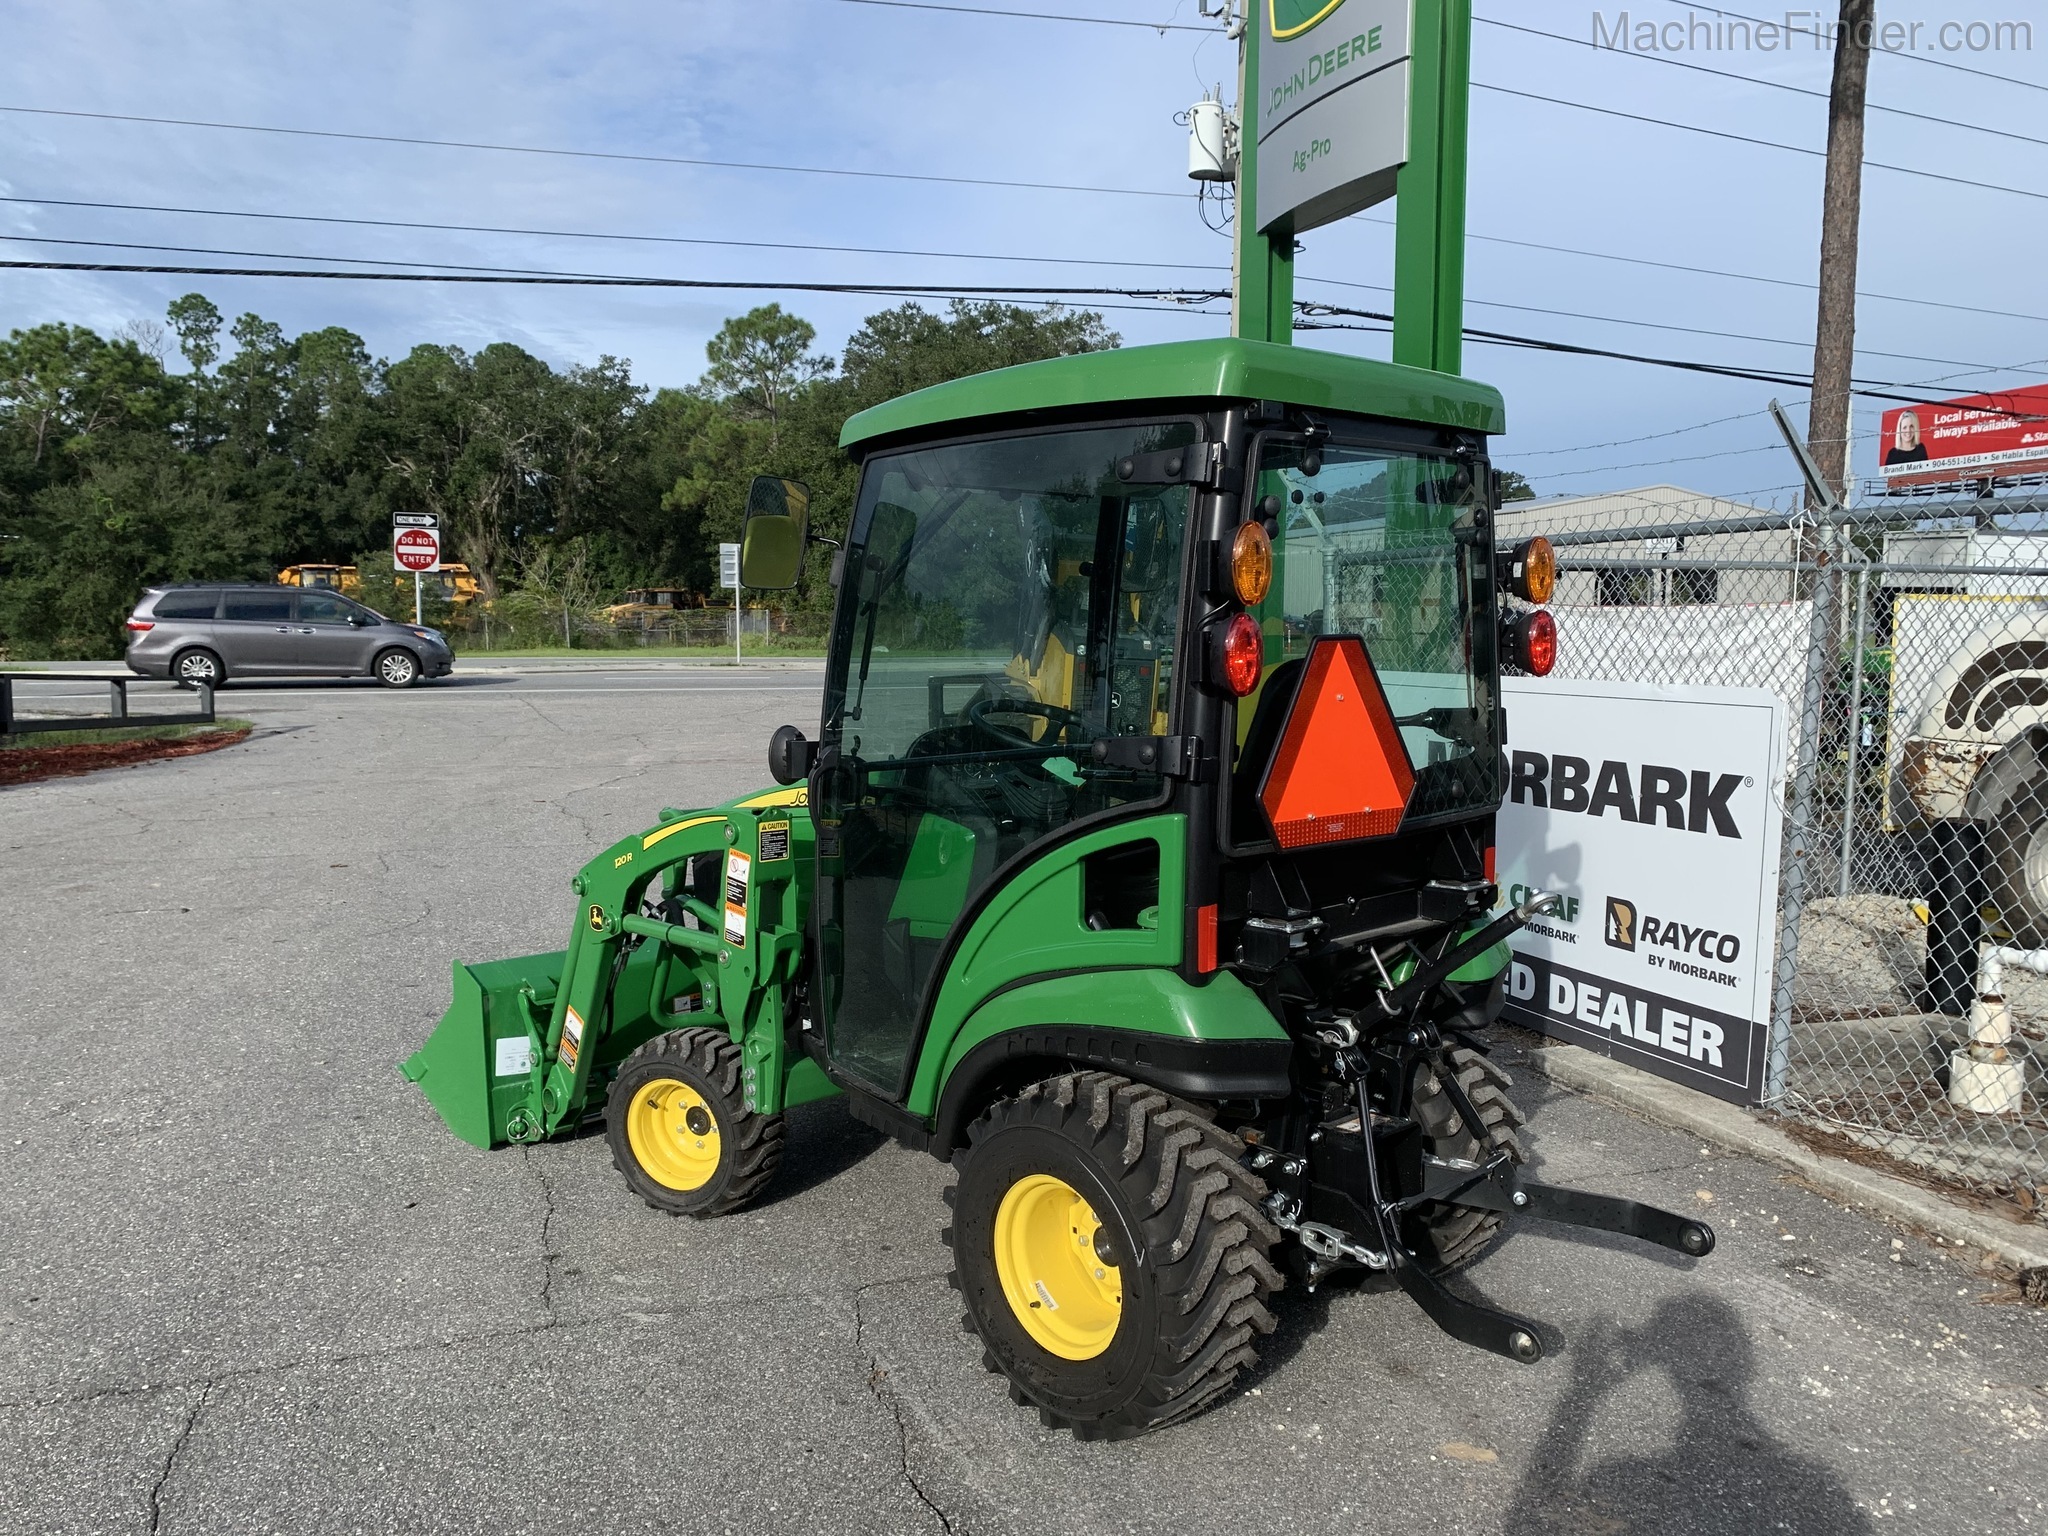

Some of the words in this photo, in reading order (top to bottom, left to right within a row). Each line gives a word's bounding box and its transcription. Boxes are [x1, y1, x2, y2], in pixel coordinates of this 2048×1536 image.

[1265, 68, 1305, 118] JOHN
[1308, 25, 1382, 86] DEERE
[1293, 137, 1331, 172] Ag-Pro
[1934, 409, 1962, 425] Local
[1933, 426, 1969, 439] always
[1883, 464, 1904, 474] Brandi
[1906, 462, 1923, 471] Mark
[1932, 455, 1981, 468] 904-551-1643
[1991, 453, 2000, 461] Se
[2001, 450, 2023, 460] Habla
[401, 536, 413, 544] DO
[416, 537, 433, 545] NOT
[402, 555, 432, 564] ENTER
[767, 821, 788, 830] CAUTION
[1640, 915, 1741, 963] RAYCO
[1648, 953, 1665, 967] BY
[1669, 959, 1738, 988] MORBARK
[1548, 973, 1725, 1068] DEALER
